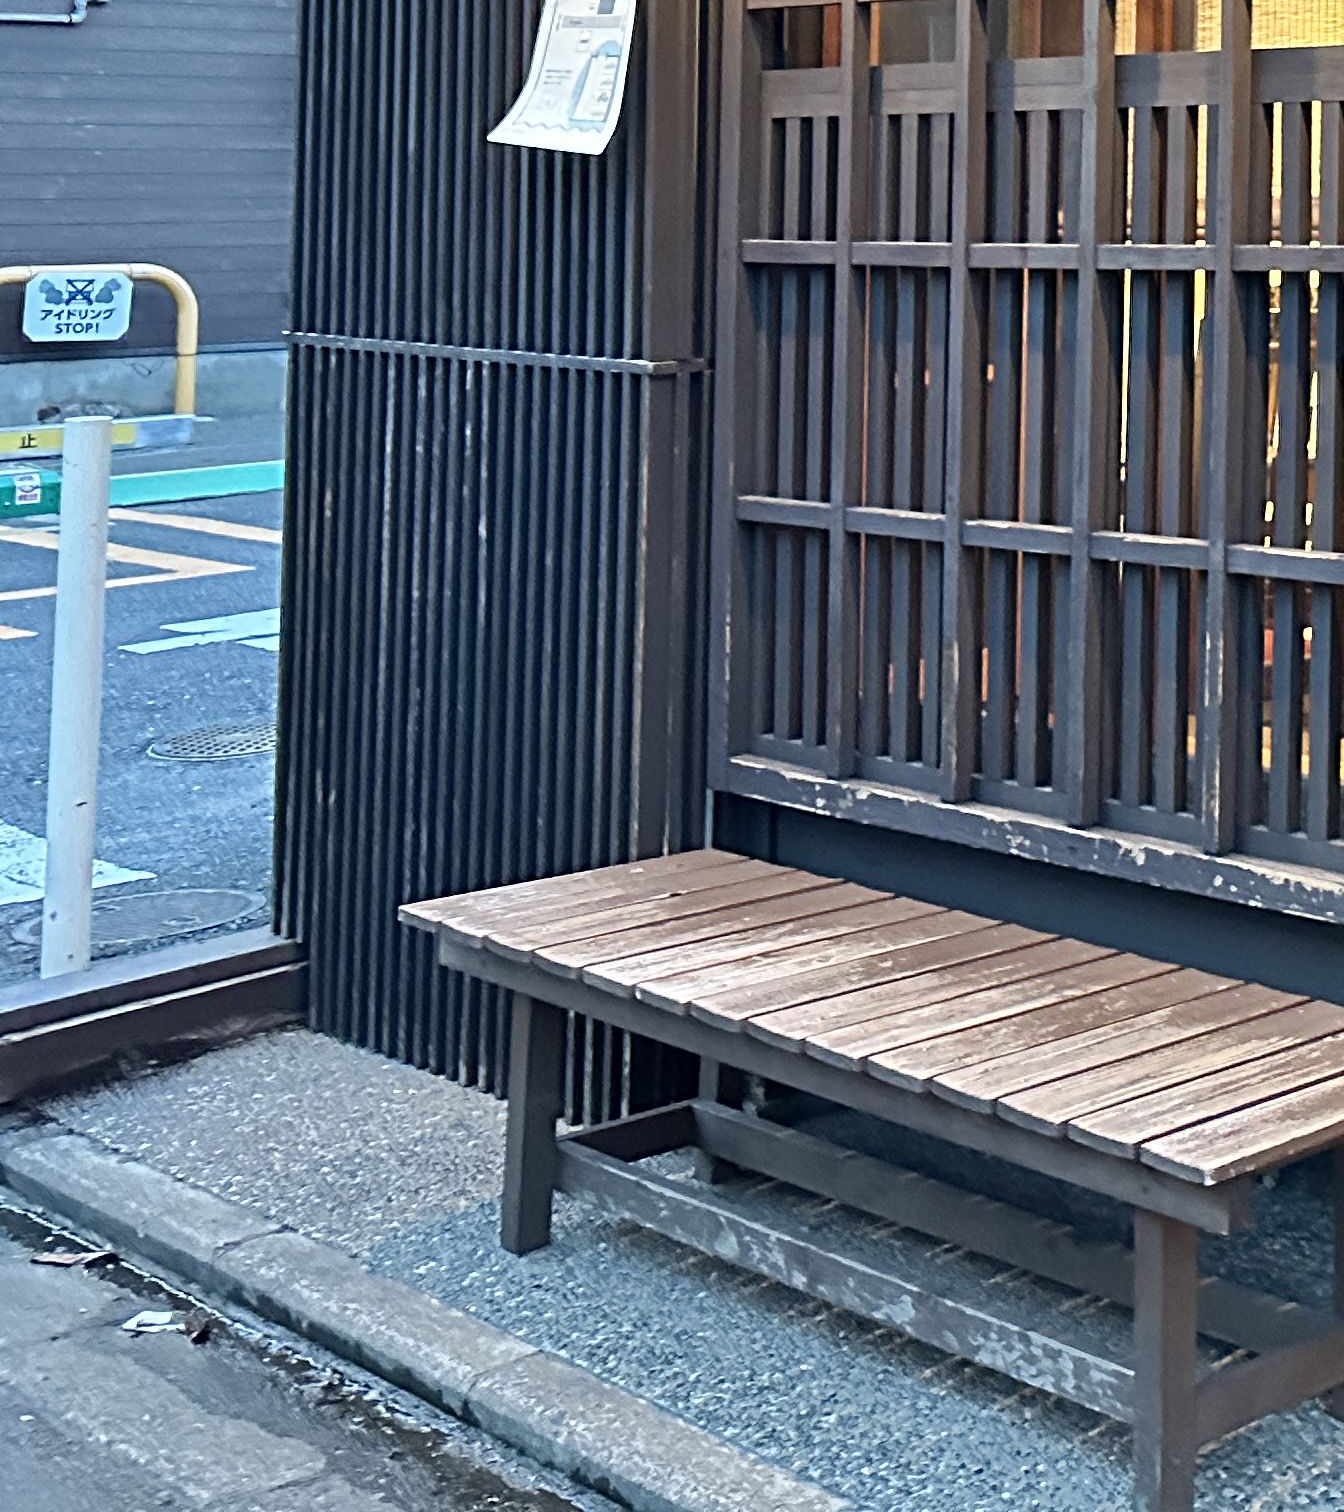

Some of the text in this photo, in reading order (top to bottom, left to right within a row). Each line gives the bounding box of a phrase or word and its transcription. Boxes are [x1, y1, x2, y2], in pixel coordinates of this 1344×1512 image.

[40, 308, 116, 321] アイドリング
[54, 322, 100, 335] STOP!
[19, 433, 38, 449] 止
